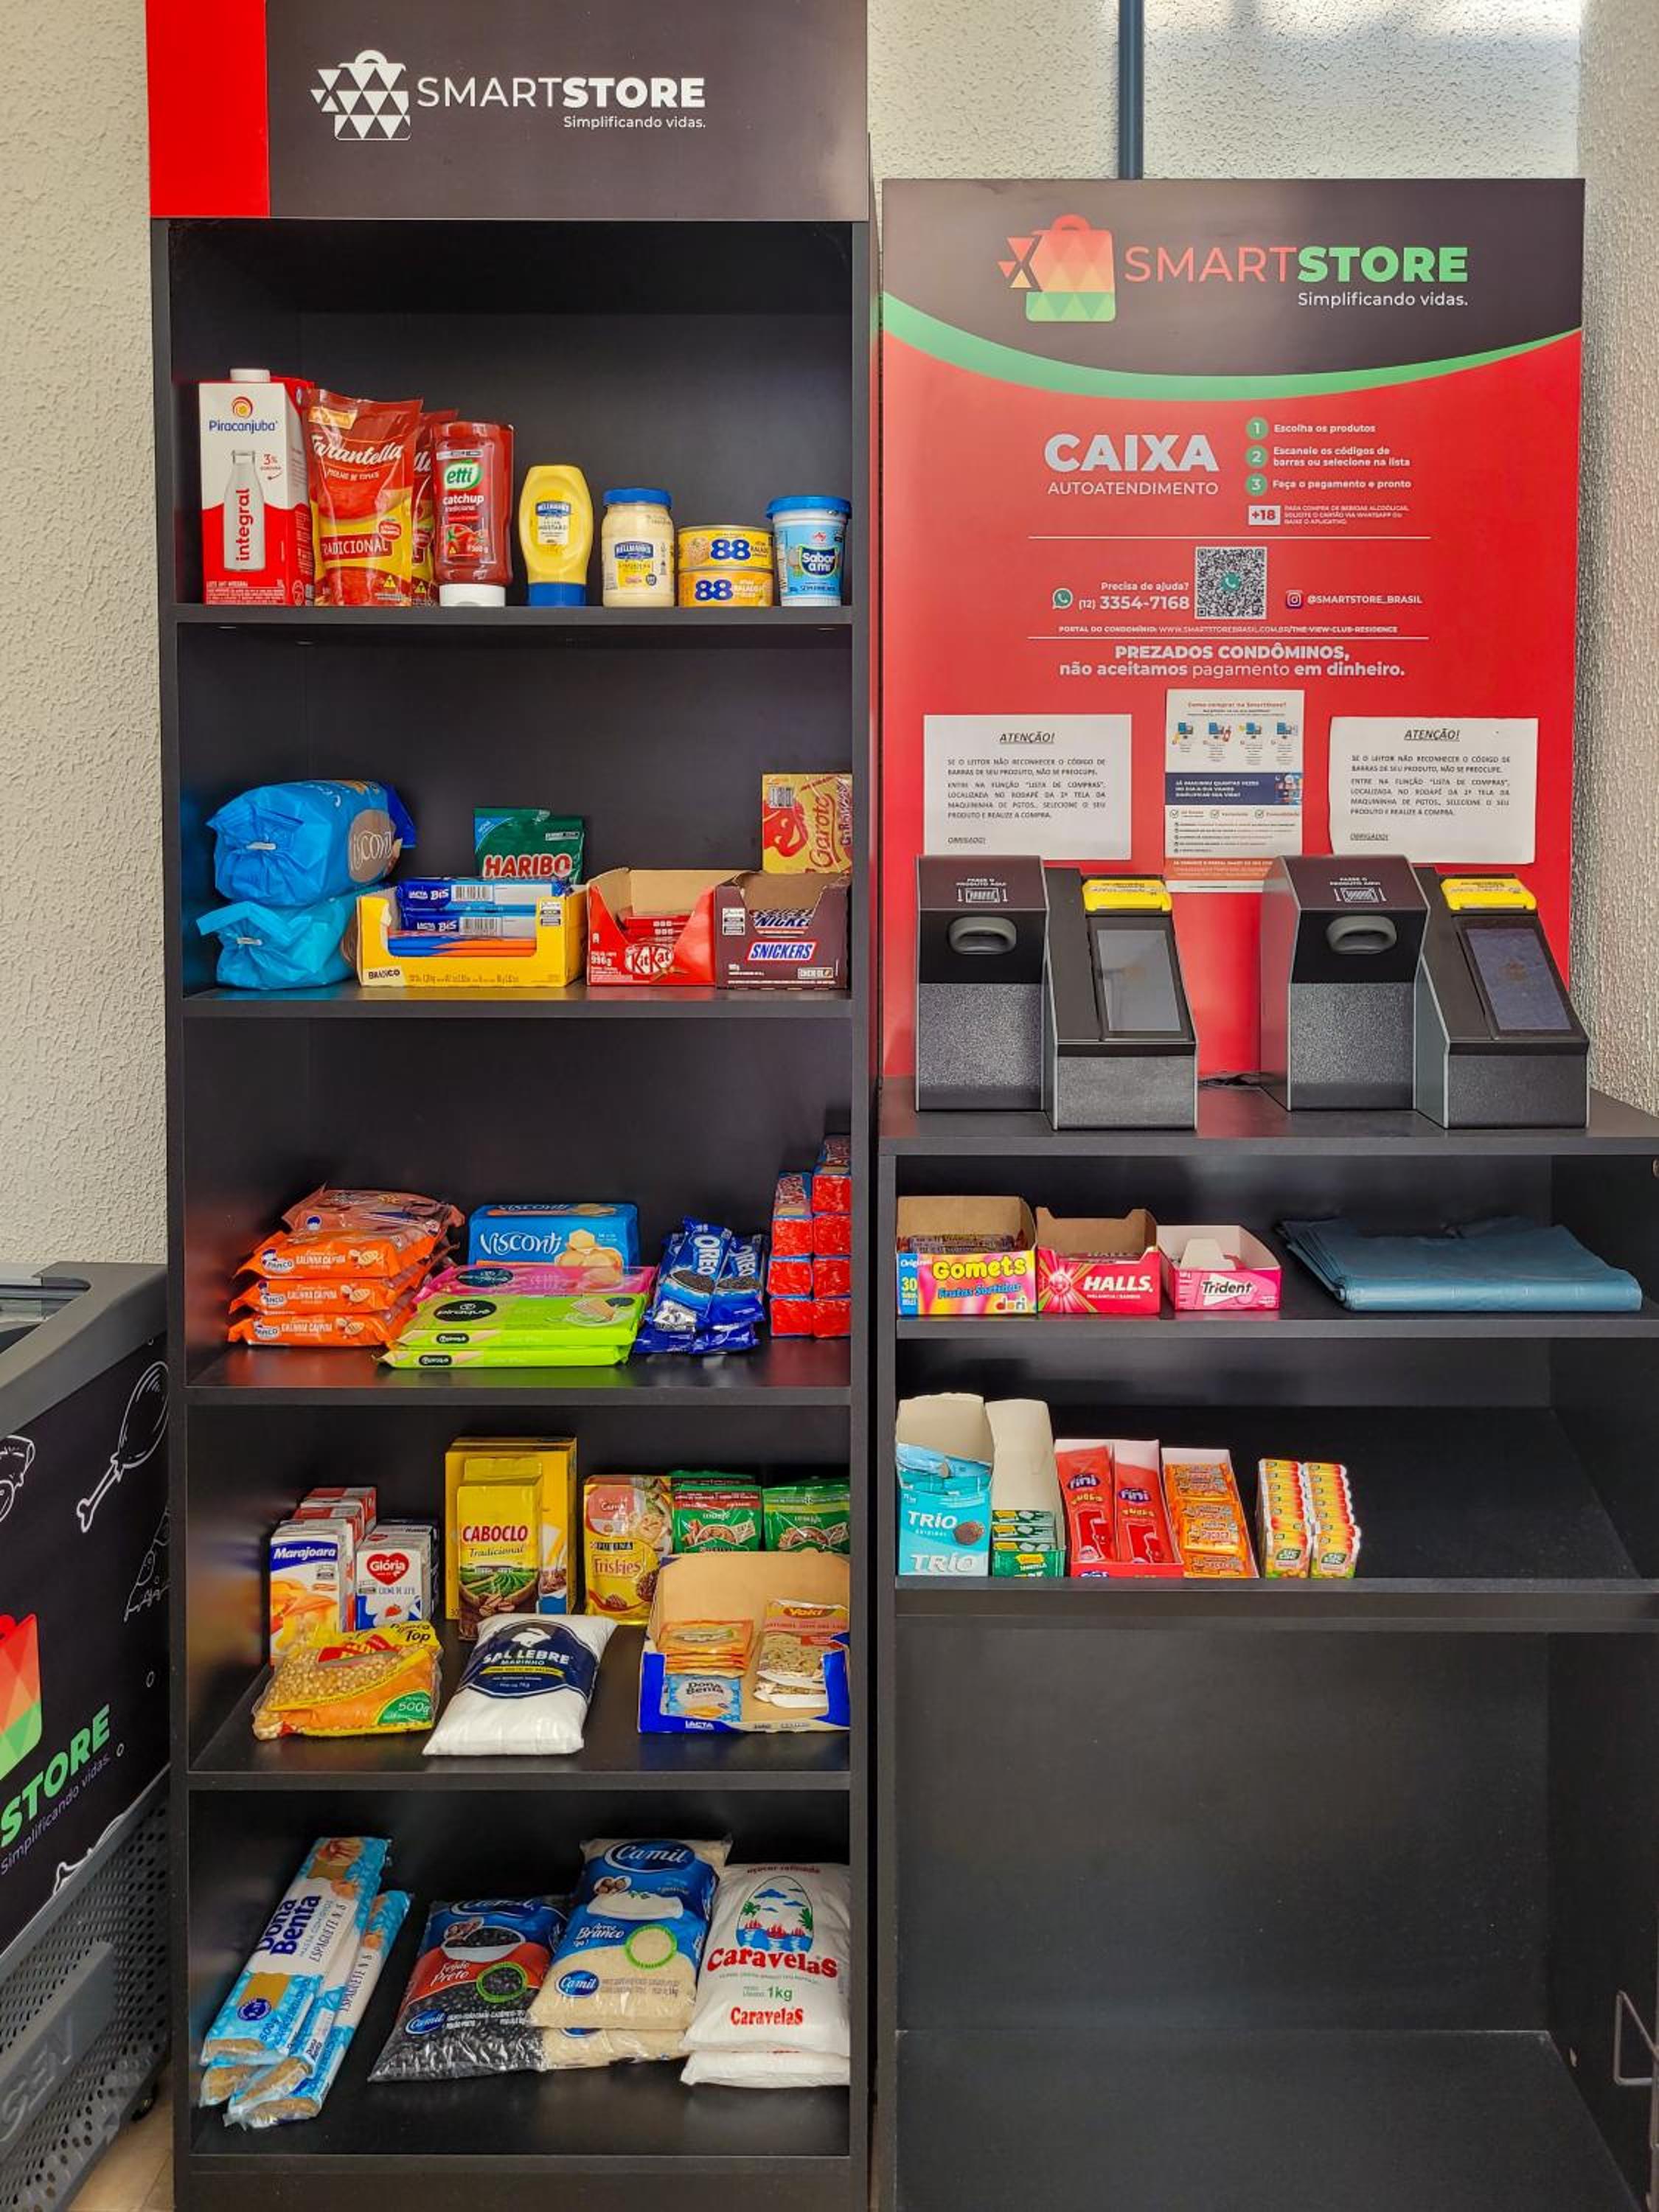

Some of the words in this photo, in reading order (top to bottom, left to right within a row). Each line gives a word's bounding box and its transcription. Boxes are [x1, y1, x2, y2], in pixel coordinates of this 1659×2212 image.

[417, 77, 705, 109] SMARTSTORE
[563, 115, 663, 131] Simplificando
[666, 116, 706, 128] vidas.
[1124, 246, 1468, 283] SMARTSTORE
[1298, 292, 1416, 309] Simplificando
[1420, 292, 1468, 307] vidas.
[209, 419, 276, 434] Piracanjuba
[1274, 424, 1313, 433] Escolha
[1329, 424, 1375, 434] produtos
[1044, 434, 1220, 473] CAIXA
[1252, 451, 1262, 462] 2
[1273, 446, 1318, 455] Escaneie
[1335, 445, 1374, 456] códigos
[1377, 446, 1390, 455] de
[1273, 458, 1305, 467] barras
[1322, 458, 1371, 467] selecione
[1389, 458, 1411, 467] lista
[1048, 481, 1219, 495] AUTOATENDIMENTO
[1251, 479, 1262, 490] 3
[1273, 480, 1295, 490] Faça
[1308, 480, 1366, 490] pagamento
[1377, 480, 1411, 490] pronto
[442, 493, 484, 506] catchup
[1251, 509, 1276, 521] +18
[235, 487, 254, 561] integral
[710, 538, 751, 561] 88
[801, 552, 835, 563] Sabor
[695, 579, 733, 602] 88
[1101, 582, 1138, 591] Precisa
[1140, 582, 1154, 591] de
[1156, 582, 1189, 592] ajuda?
[1079, 599, 1096, 611] (12)
[1100, 595, 1189, 610] 3354-7168
[1307, 594, 1422, 605] @SMARTSTORE_BRASIL
[1115, 645, 1213, 659] PREZADOS
[1218, 642, 1349, 661] CONDÔMINOS,
[1060, 661, 1092, 676] não
[1096, 661, 1187, 676] aceitamos
[1192, 664, 1290, 680] pagamento
[1294, 665, 1322, 676] em
[1326, 661, 1405, 676] dinheiro.
[999, 731, 1055, 745] ATENÇÃO!
[1403, 728, 1460, 742] ATENÇÃO!
[484, 854, 572, 878] HARIBO
[750, 942, 813, 959] SNICKERS
[693, 1234, 720, 1275] OREO
[932, 1255, 1027, 1280] Gomets
[901, 1276, 917, 1291] 30
[1083, 1276, 1148, 1292] HALLS
[1203, 1280, 1253, 1294] Trident
[995, 1295, 1026, 1311] dori
[462, 1526, 528, 1542] CABOCLO
[274, 1546, 336, 1561] Marajoara
[470, 1545, 524, 1558] Tradicional
[369, 1559, 405, 1572] Glória
[594, 1558, 641, 1574] Friskies
[406, 1630, 431, 1644] Top
[482, 1649, 512, 1664] SAL
[518, 1649, 570, 1664] LEBRE
[685, 1721, 714, 1730] LACTA
[1, 1785, 80, 1876] Simplificando
[616, 1845, 685, 1863] Camil
[270, 1894, 321, 1956] Benta
[575, 1927, 625, 1939] Branco
[560, 1976, 596, 1989] Camil
[768, 1986, 793, 2001] 1kg
[410, 2012, 445, 2028] Camil
[731, 2006, 804, 2025] Caravelas
